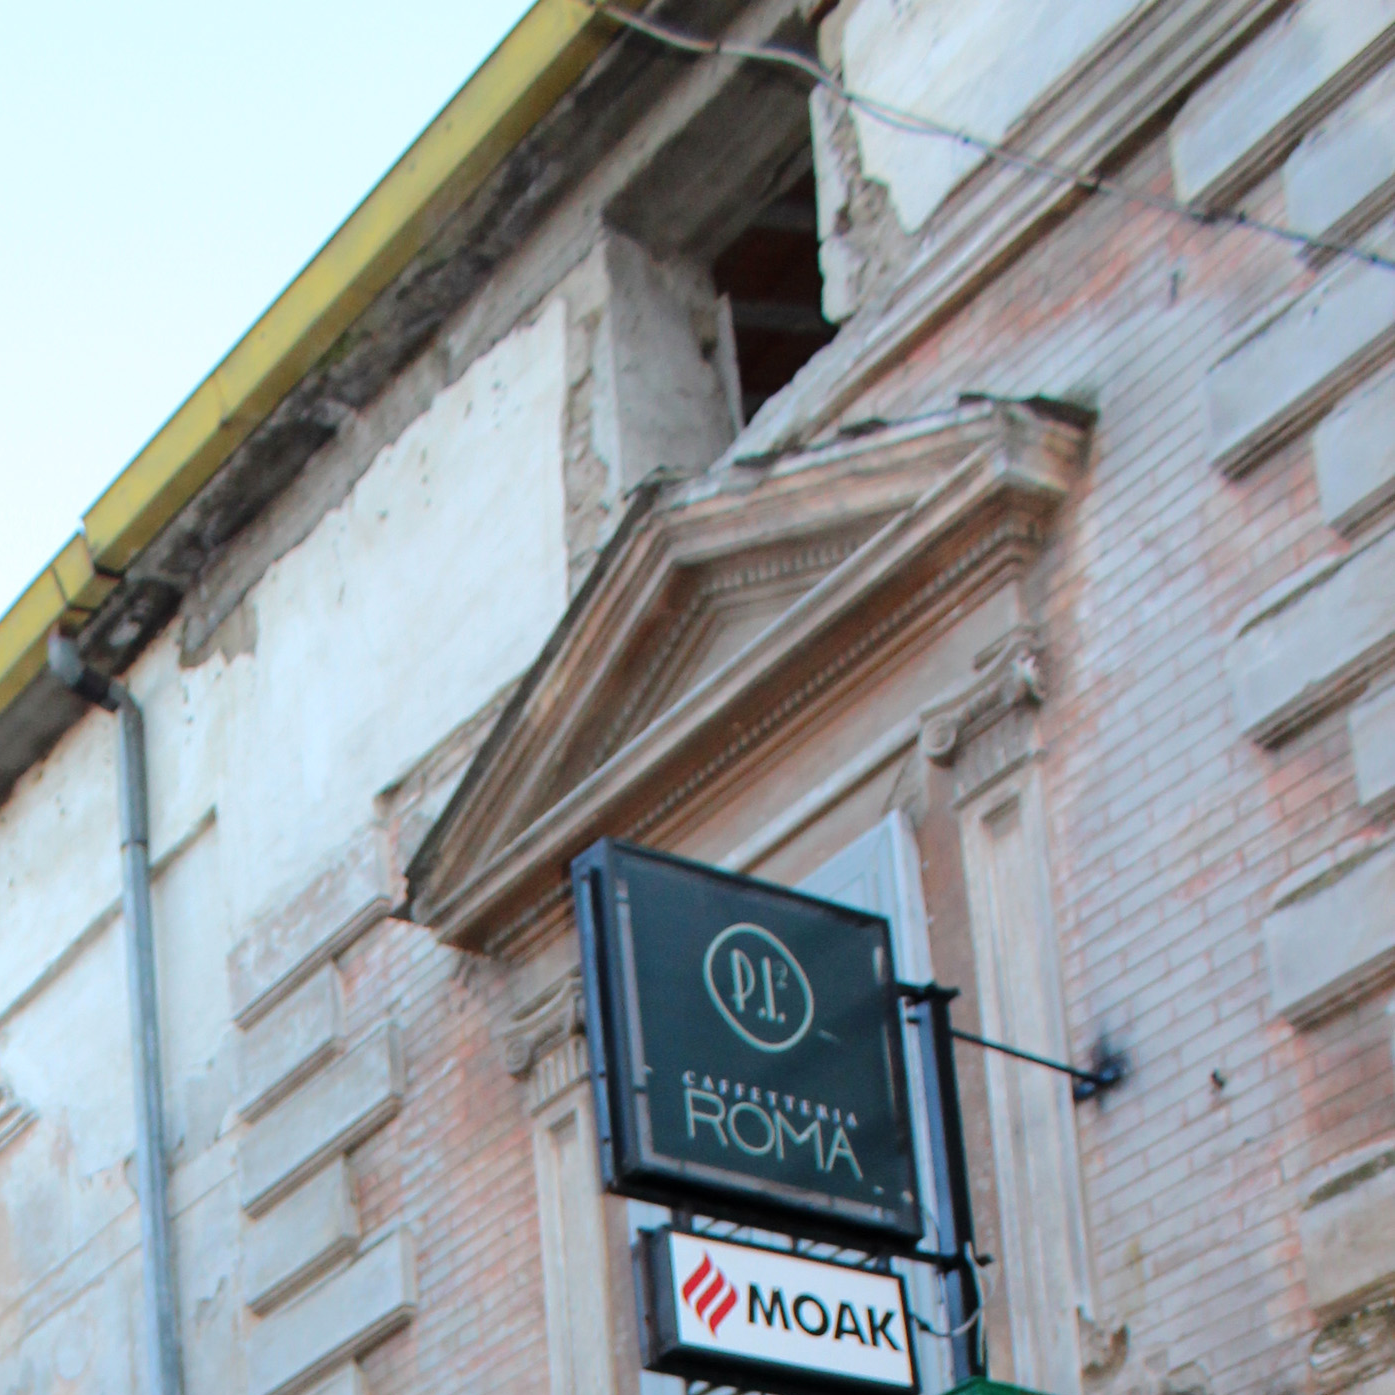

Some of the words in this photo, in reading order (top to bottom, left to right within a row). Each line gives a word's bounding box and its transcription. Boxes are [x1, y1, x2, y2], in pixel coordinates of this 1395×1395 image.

[682, 1070, 858, 1129] CAFFETTERIA
[684, 1087, 863, 1181] ROMA
[748, 1283, 901, 1351] MOAK
